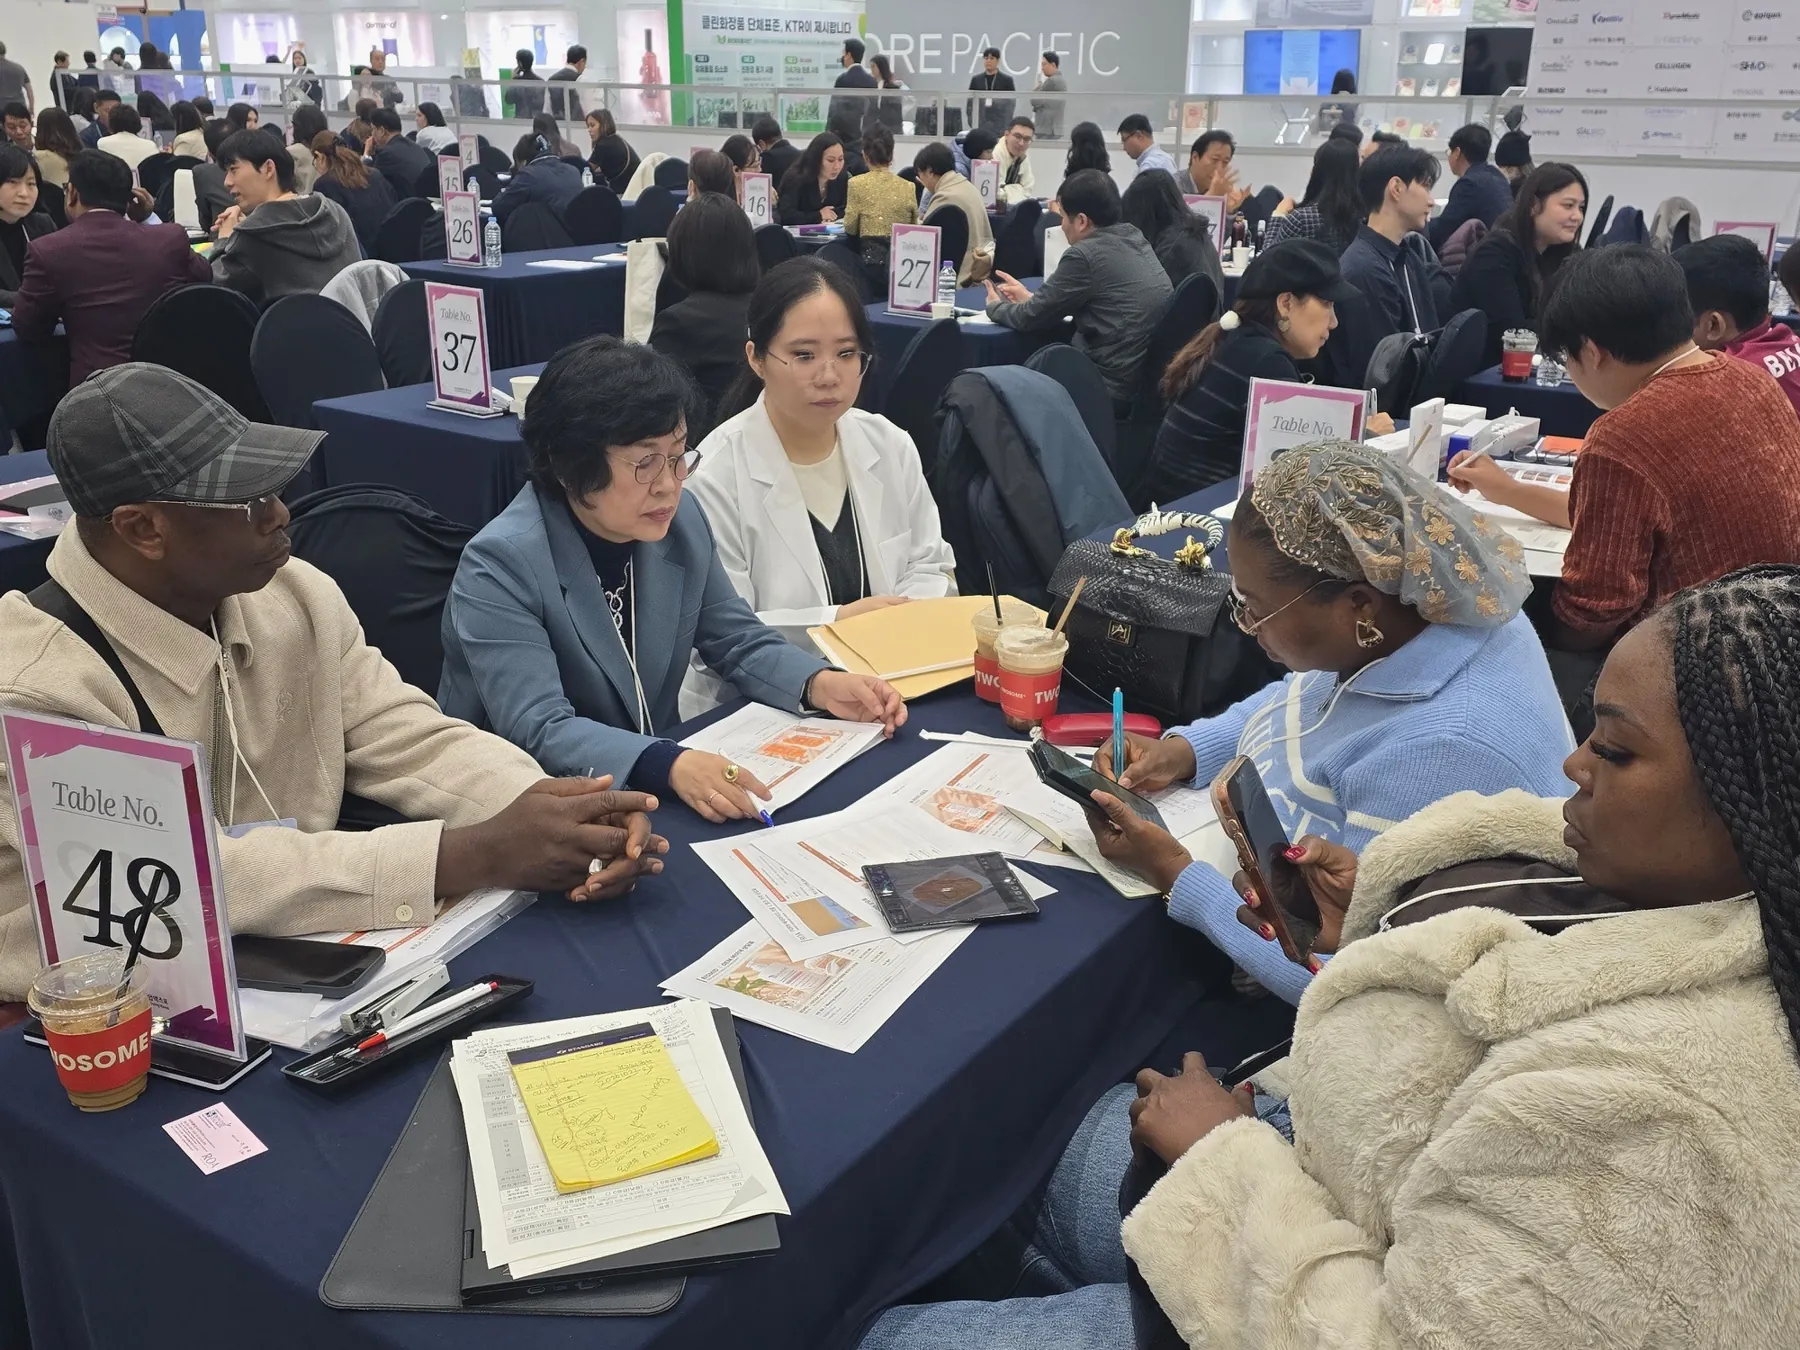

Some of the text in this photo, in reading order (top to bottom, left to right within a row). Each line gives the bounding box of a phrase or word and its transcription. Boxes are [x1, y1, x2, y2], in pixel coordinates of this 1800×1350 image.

[702, 15, 852, 34] 클린화장품 단체표준, KTR이 제시합니다
[465, 149, 473, 164] 4
[980, 179, 990, 197] 6
[748, 196, 767, 217] 16
[452, 218, 473, 244] 26
[897, 258, 932, 289] 27
[440, 308, 472, 322] Table No.
[442, 331, 477, 374] 37
[1272, 415, 1335, 438] Table No.
[52, 781, 164, 827] Table No.
[62, 848, 184, 960] 48
